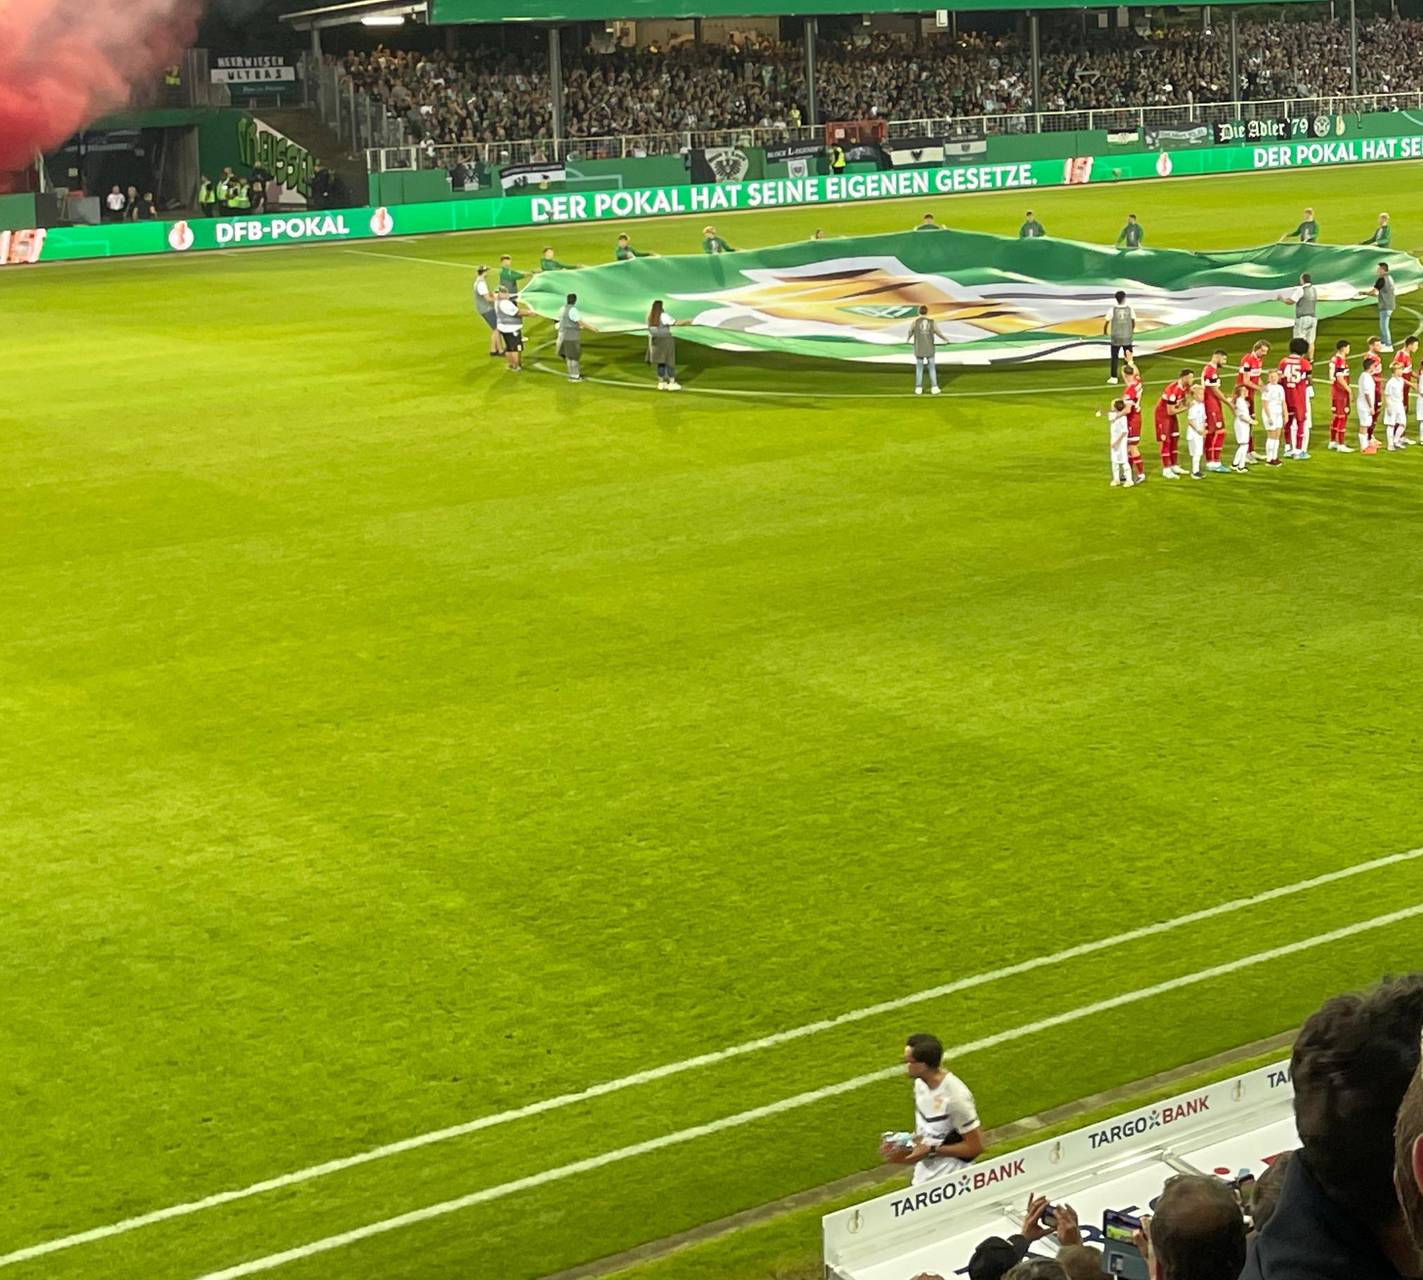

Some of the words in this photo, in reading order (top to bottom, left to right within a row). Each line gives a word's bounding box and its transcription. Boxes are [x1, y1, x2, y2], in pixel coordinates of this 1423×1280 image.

[227, 68, 282, 81] ULTRAS
[1218, 122, 1246, 142] Die
[1248, 118, 1286, 138] Adler
[1254, 147, 1292, 168] DER
[1297, 142, 1358, 164] POKAL
[1362, 139, 1397, 160] HAT
[531, 195, 587, 222] DER
[594, 189, 685, 217] POKAL
[690, 184, 742, 211] HAT
[747, 178, 819, 207] SEINE
[825, 171, 929, 200] EIGENEN
[935, 164, 1038, 192] GESETZE.
[216, 215, 350, 243] DFB-POKAL
[1284, 363, 1302, 384] 45
[890, 1182, 957, 1218] TARGO
[973, 1158, 1026, 1191] BANK
[1087, 1116, 1147, 1150] TARGO
[1160, 1094, 1210, 1126] BANK
[1266, 1070, 1293, 1089] TA
